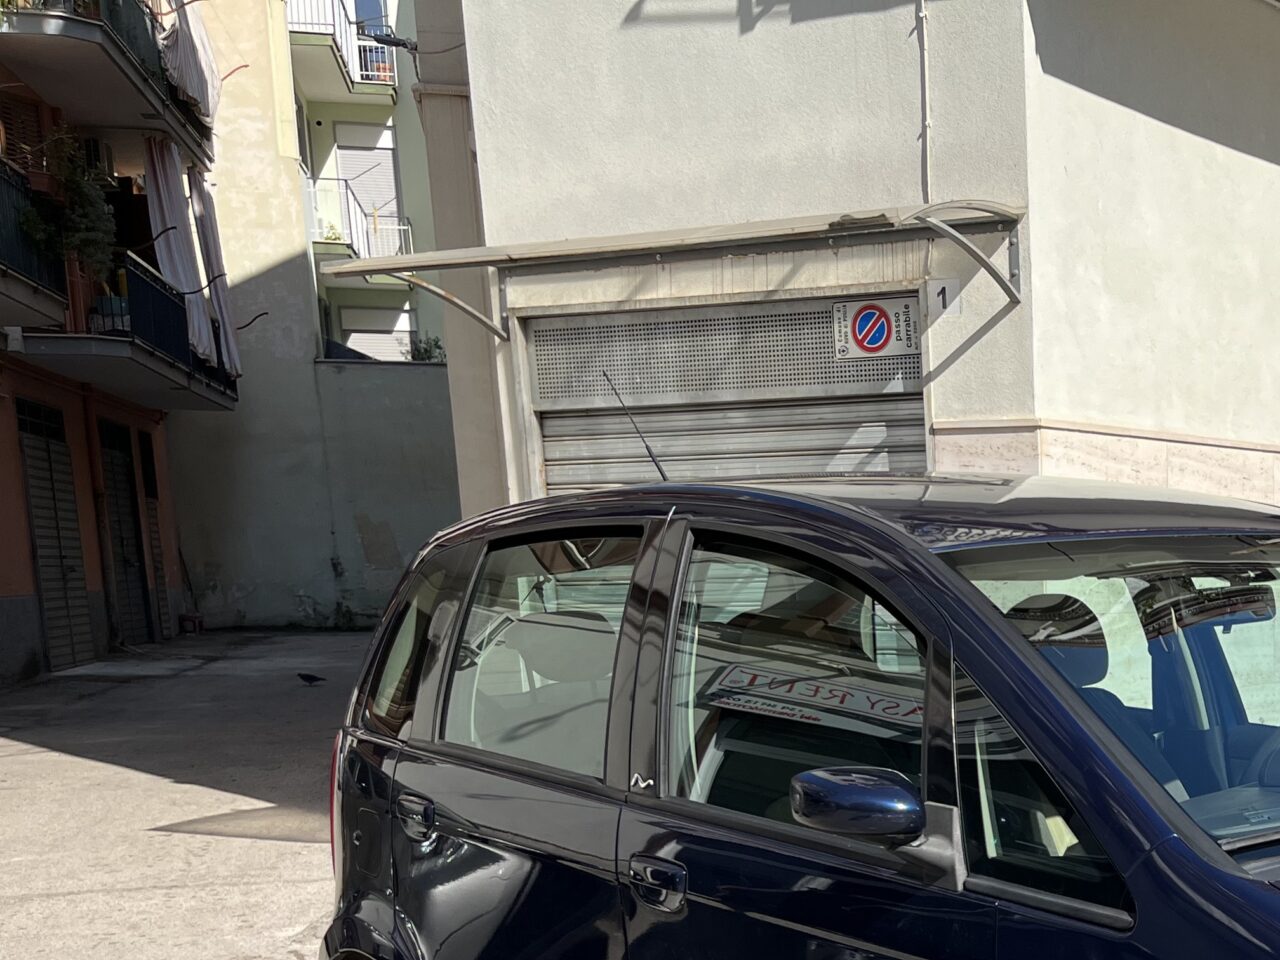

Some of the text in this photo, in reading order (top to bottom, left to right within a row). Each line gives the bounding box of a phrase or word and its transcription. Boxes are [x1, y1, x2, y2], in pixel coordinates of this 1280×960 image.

[937, 286, 948, 309] 1
[894, 312, 903, 342] passo
[902, 304, 913, 348] carrabile
